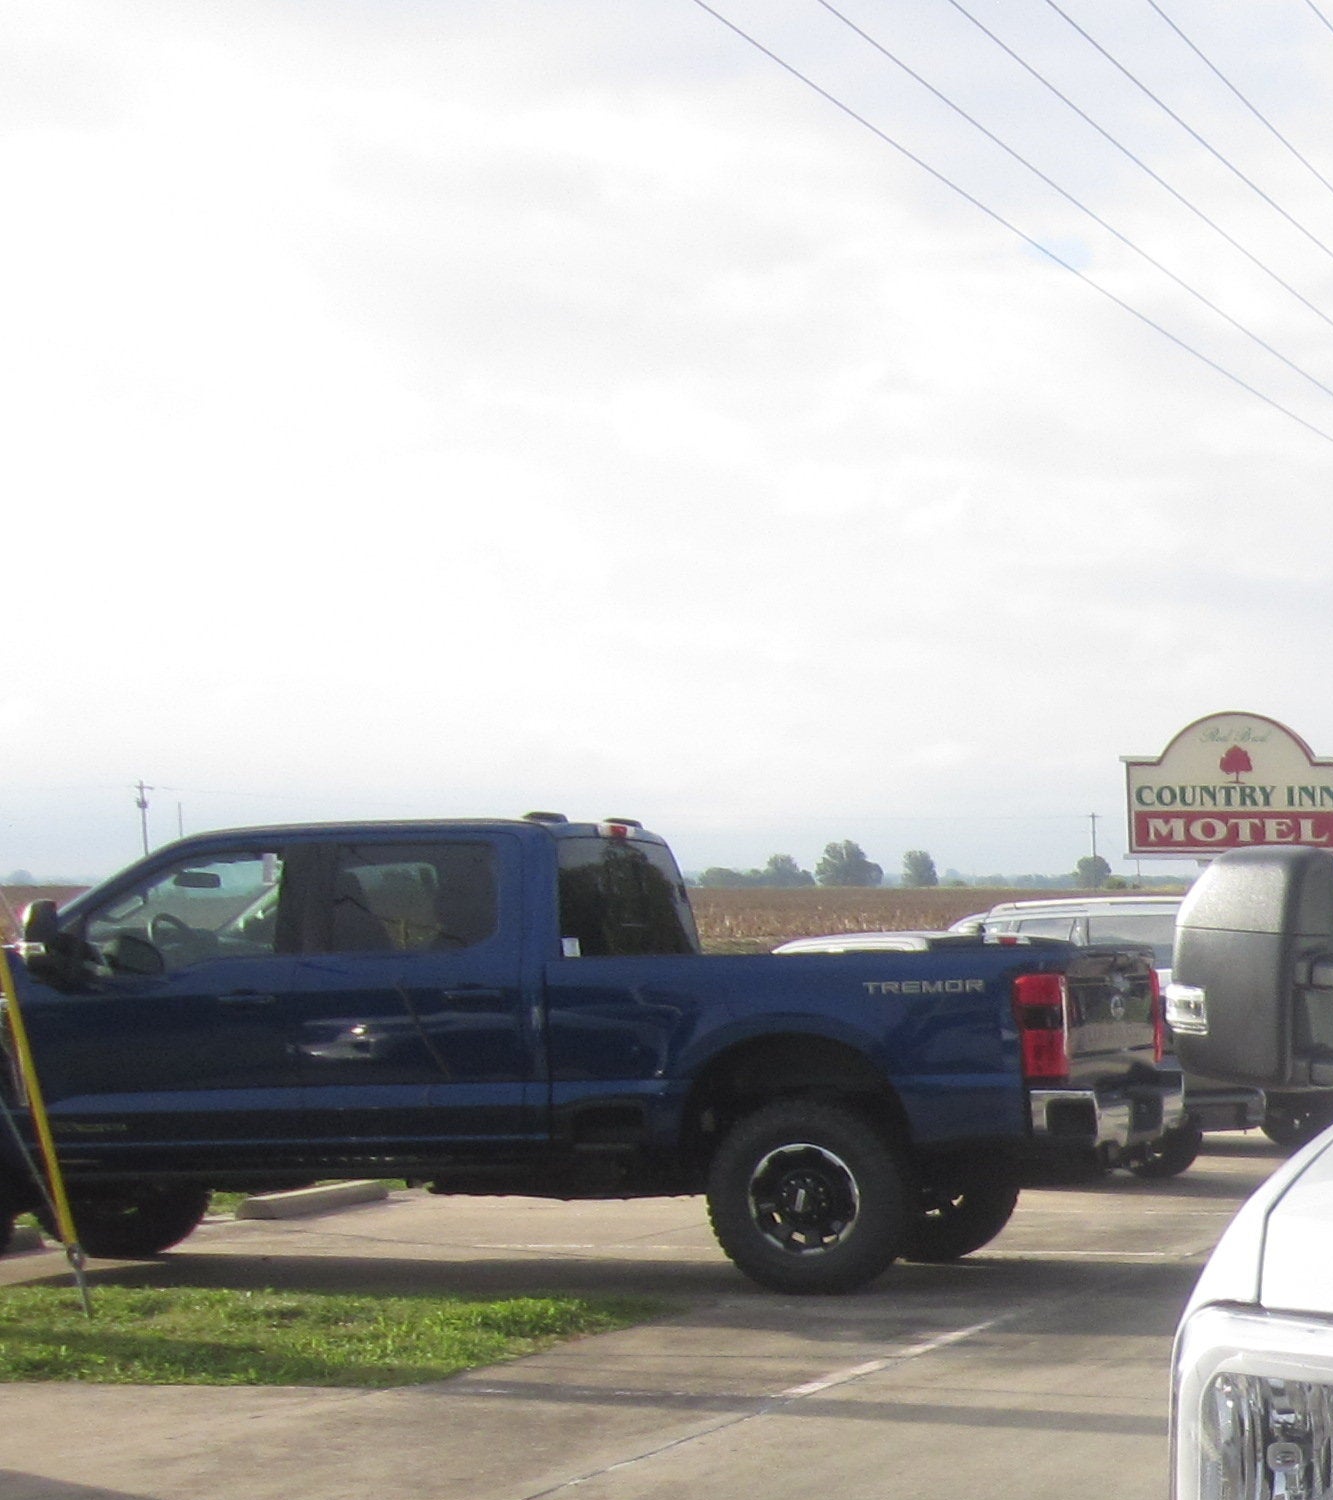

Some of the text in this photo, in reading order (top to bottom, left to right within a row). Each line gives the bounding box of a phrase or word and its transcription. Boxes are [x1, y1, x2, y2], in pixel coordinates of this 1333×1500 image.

[1135, 785, 1276, 808] COUNTRY
[1147, 817, 1330, 843] MOTEL
[862, 979, 985, 995] TREMOR
